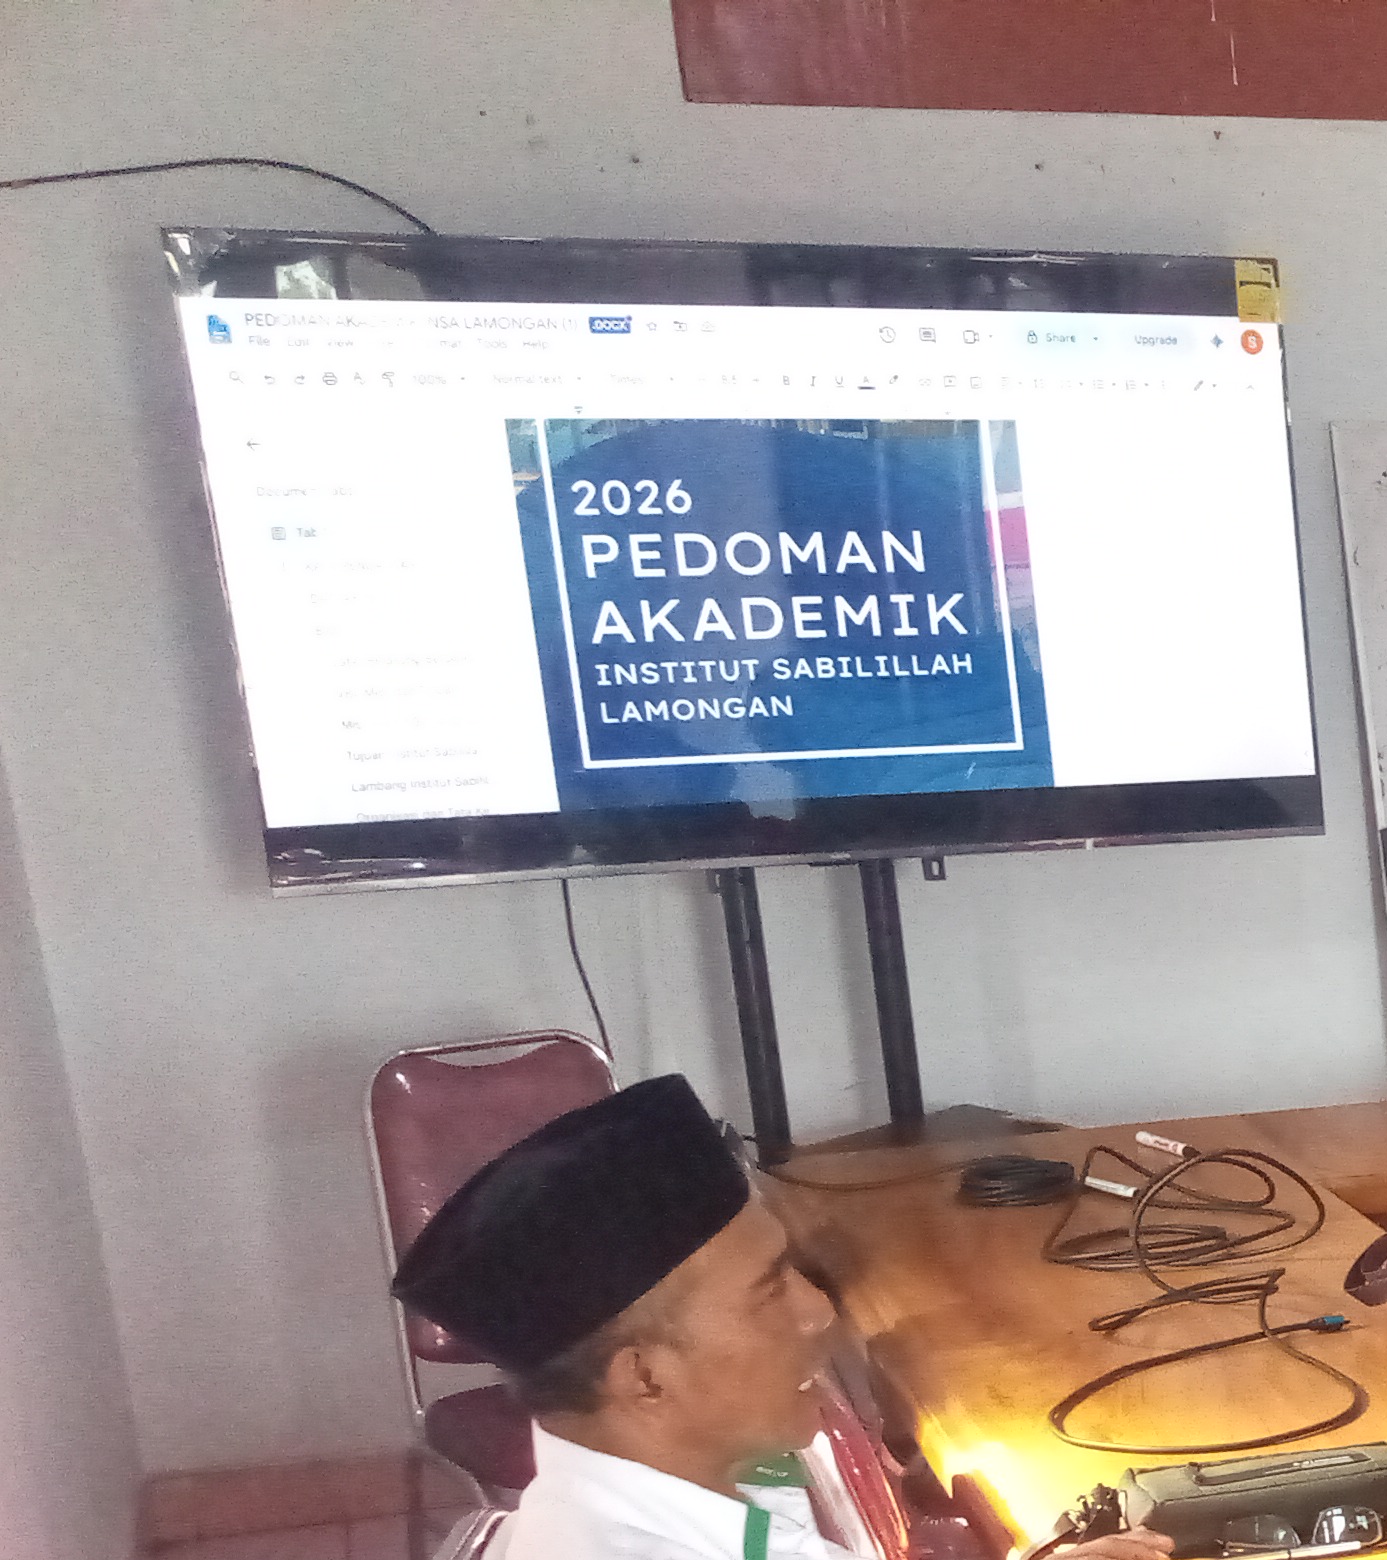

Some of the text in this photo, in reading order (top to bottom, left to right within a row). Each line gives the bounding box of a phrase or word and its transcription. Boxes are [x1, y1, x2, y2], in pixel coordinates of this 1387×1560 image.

[243, 313, 330, 328] PEDOMAN
[464, 316, 557, 331] LAMONGAN
[248, 335, 270, 347] File
[1045, 332, 1077, 344] Share
[1134, 334, 1178, 347] Upgrade
[571, 479, 692, 516] 2026
[581, 530, 926, 579] PEDOMAN
[591, 592, 969, 644] AKADEMIK
[594, 652, 973, 686] INSTITUT SABILILLAH
[600, 694, 794, 724] LAMONGAN
[351, 780, 407, 793] Lambang
[410, 777, 451, 790] Institut
